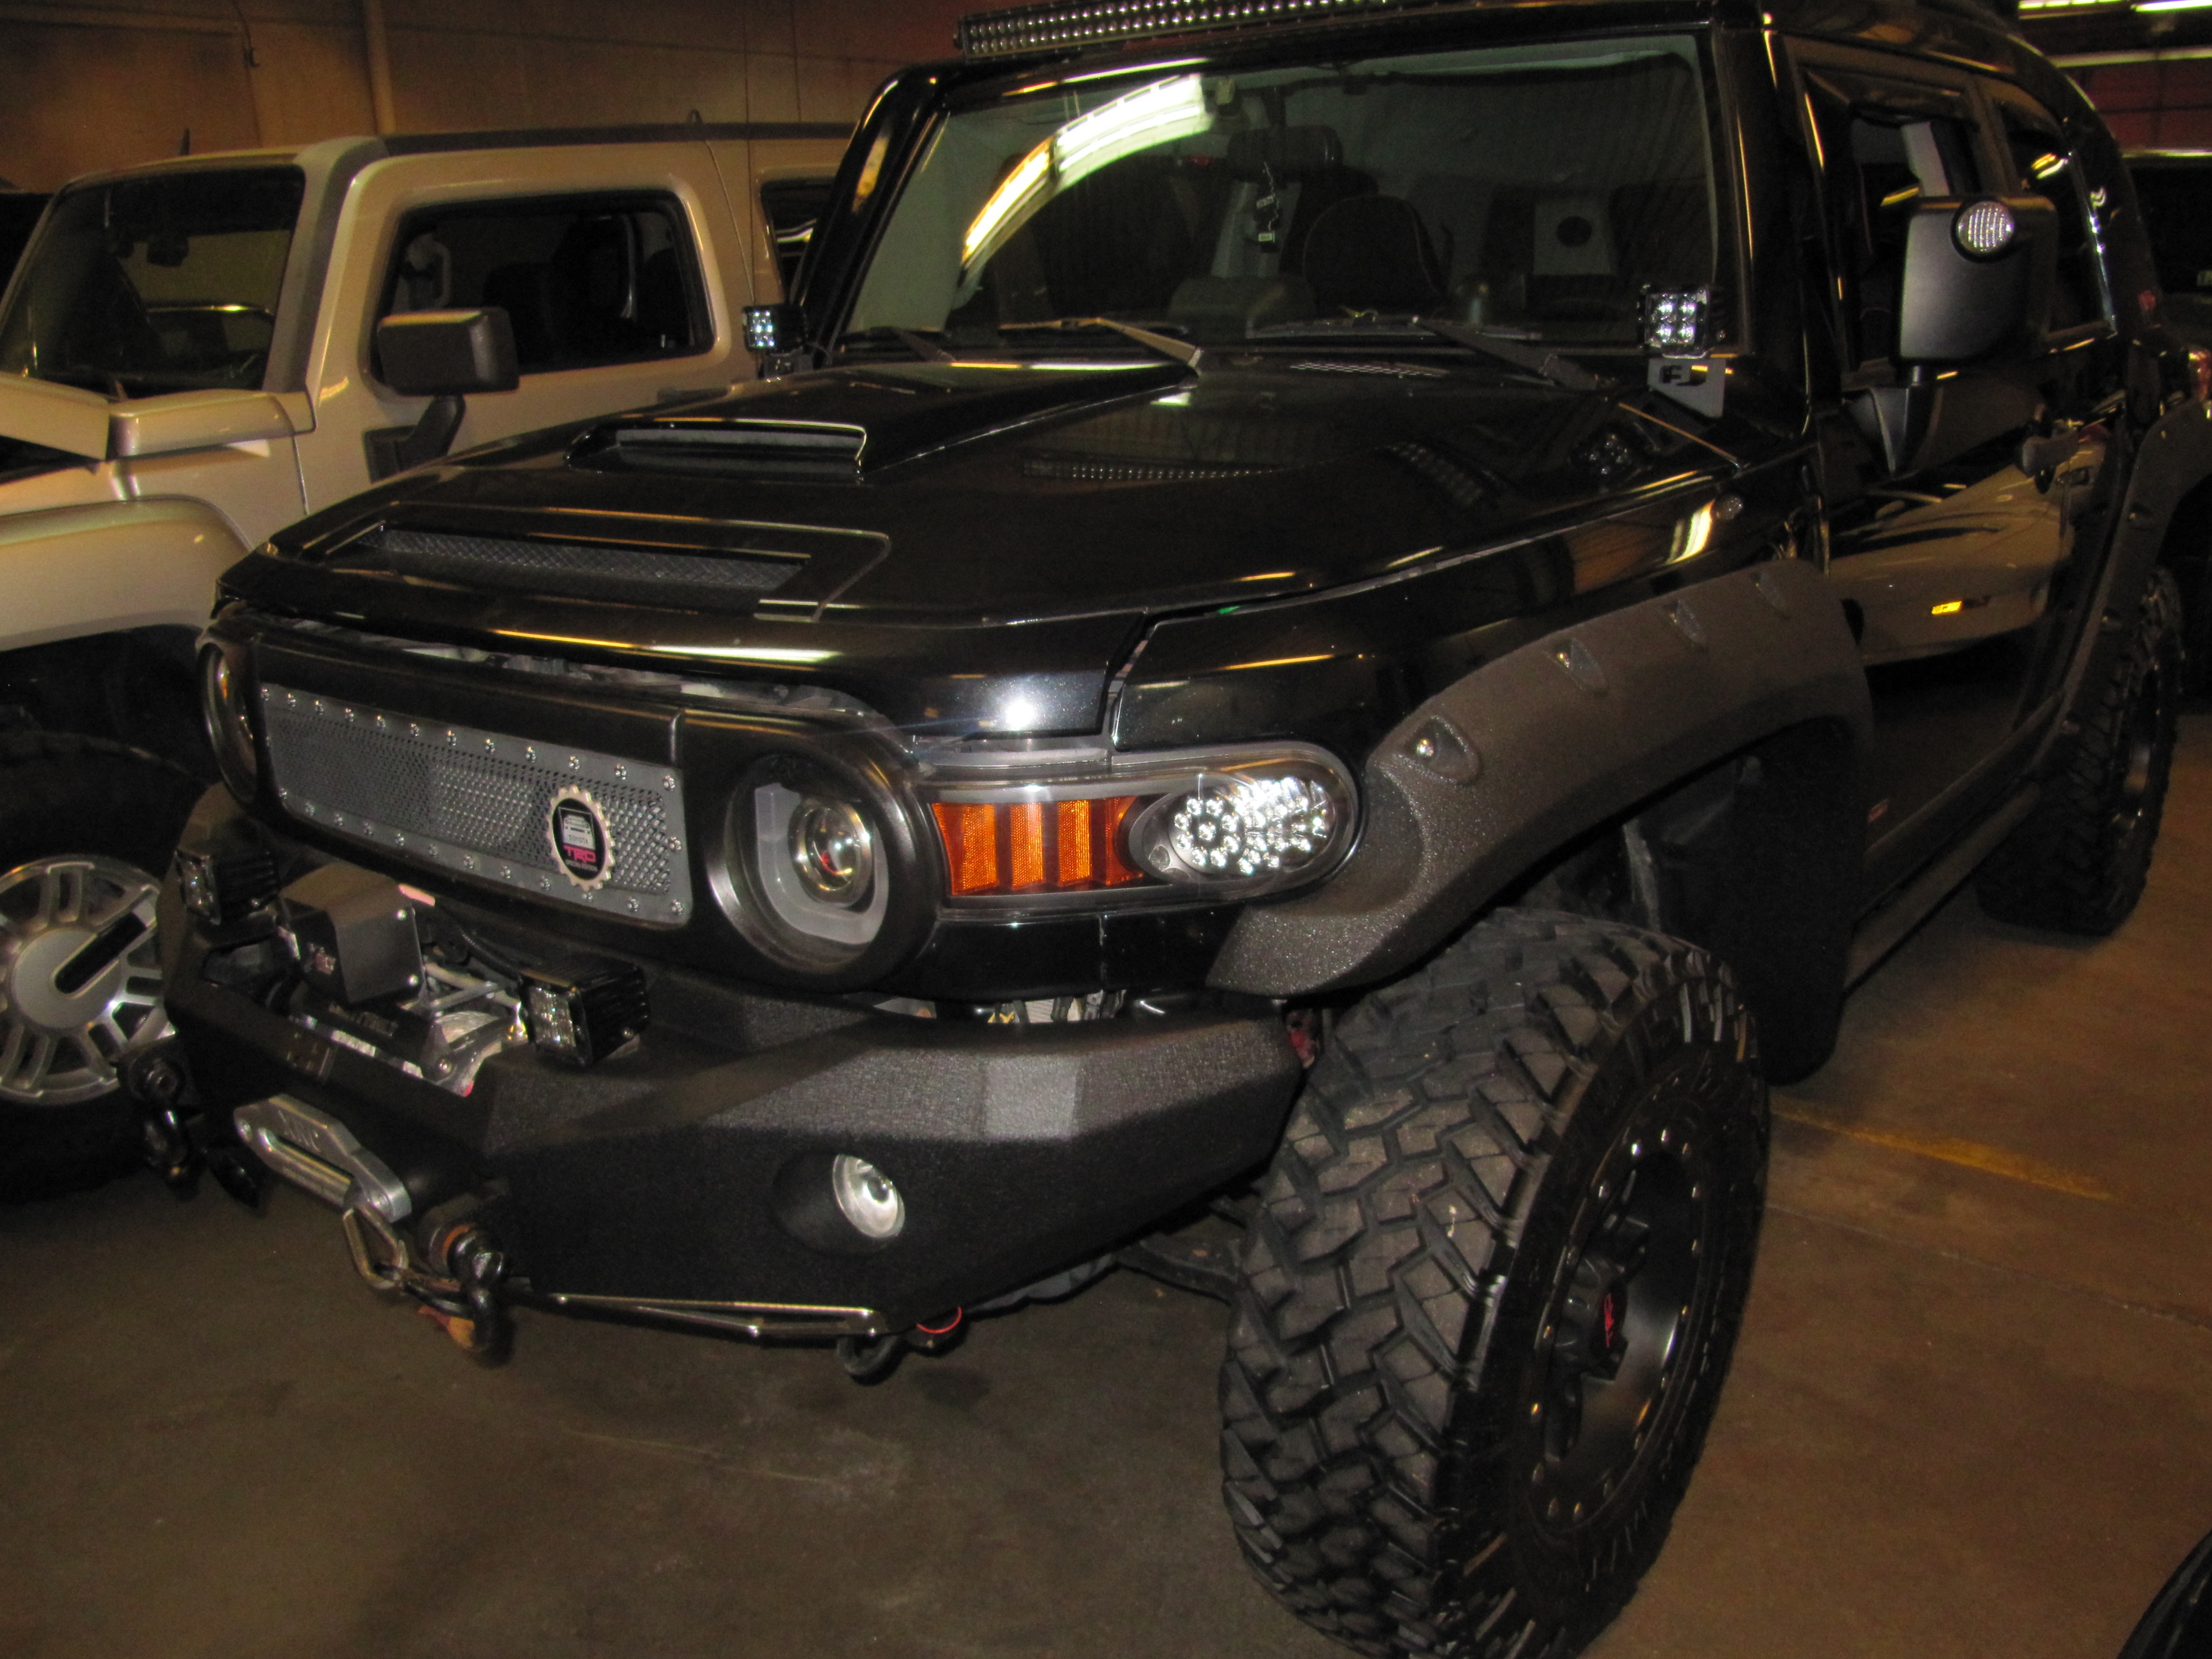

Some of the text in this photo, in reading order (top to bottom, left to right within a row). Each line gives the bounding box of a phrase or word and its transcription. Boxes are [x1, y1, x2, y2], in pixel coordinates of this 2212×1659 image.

[1660, 364, 1709, 387] FJ
[569, 834, 589, 845] TOYOTA
[564, 845, 597, 863] TRD
